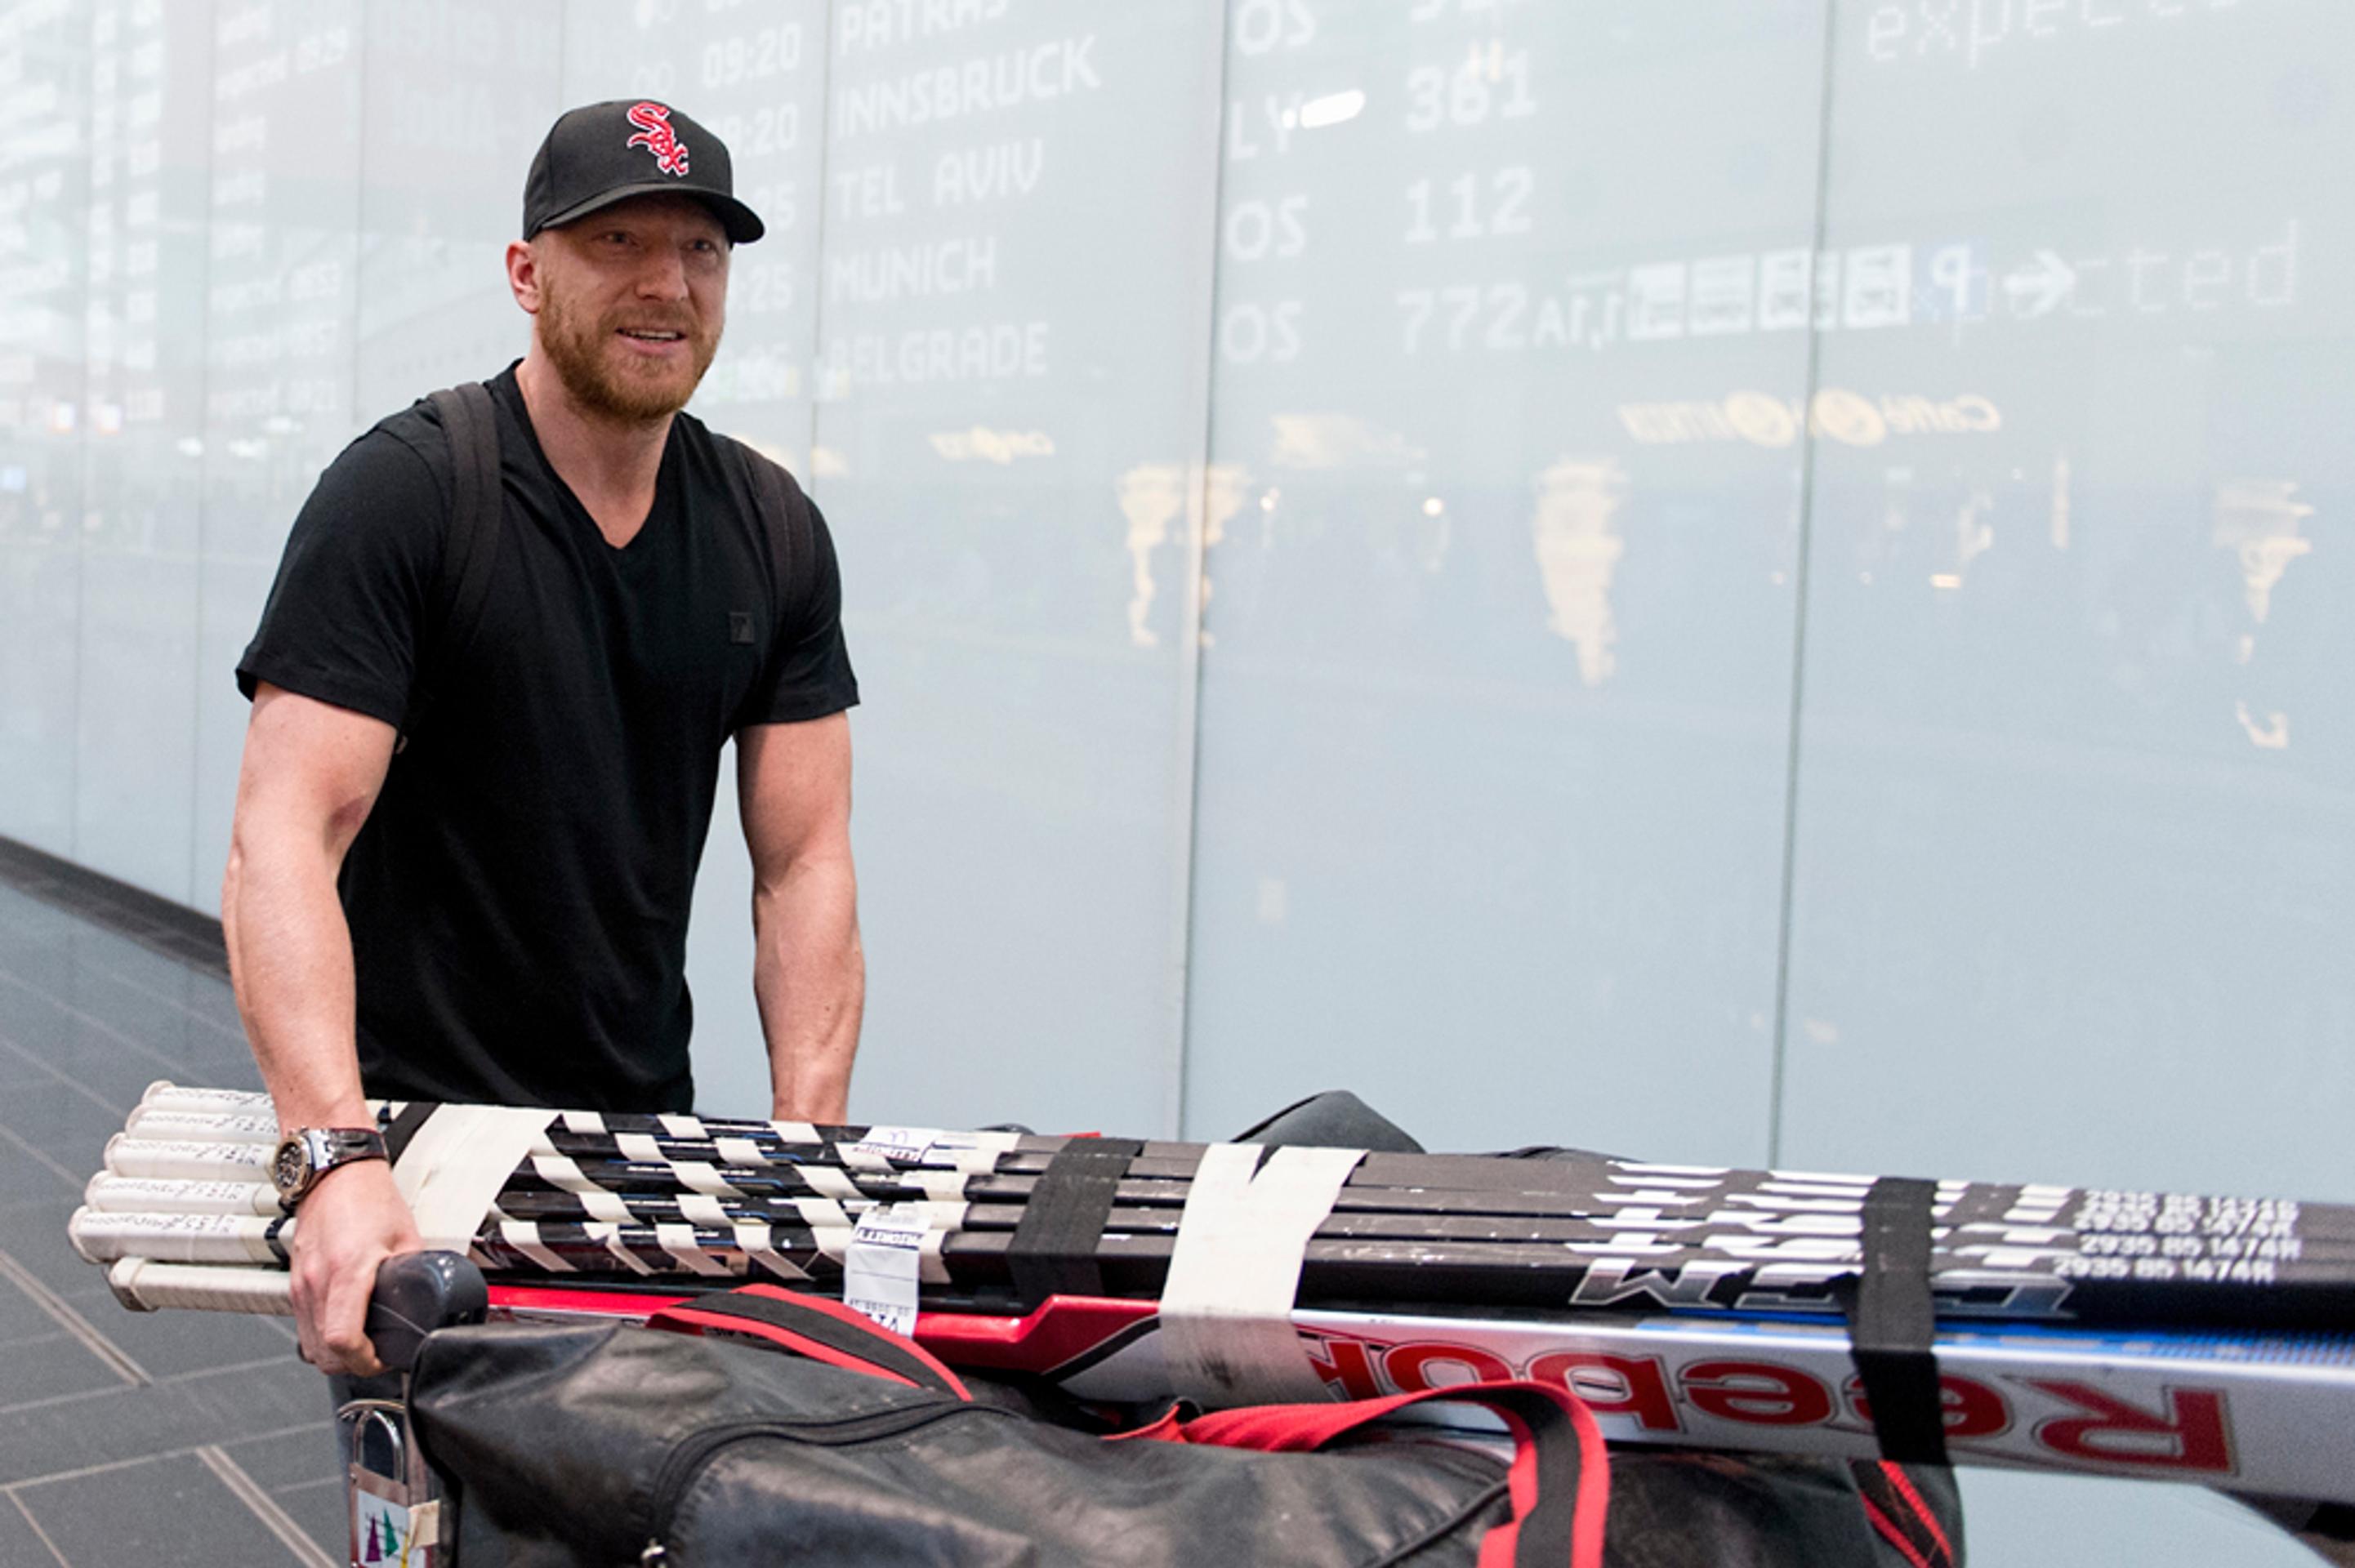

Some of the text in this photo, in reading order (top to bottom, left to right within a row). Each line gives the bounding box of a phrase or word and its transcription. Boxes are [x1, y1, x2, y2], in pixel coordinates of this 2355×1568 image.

[702, 22, 1101, 137] 09:20 INNSBRUCK
[707, 102, 1043, 221] 9:20 TEL AVIV
[1226, 167, 1535, 262] OS 112
[829, 236, 997, 305] MUNICH
[1222, 282, 1528, 365] OS 772
